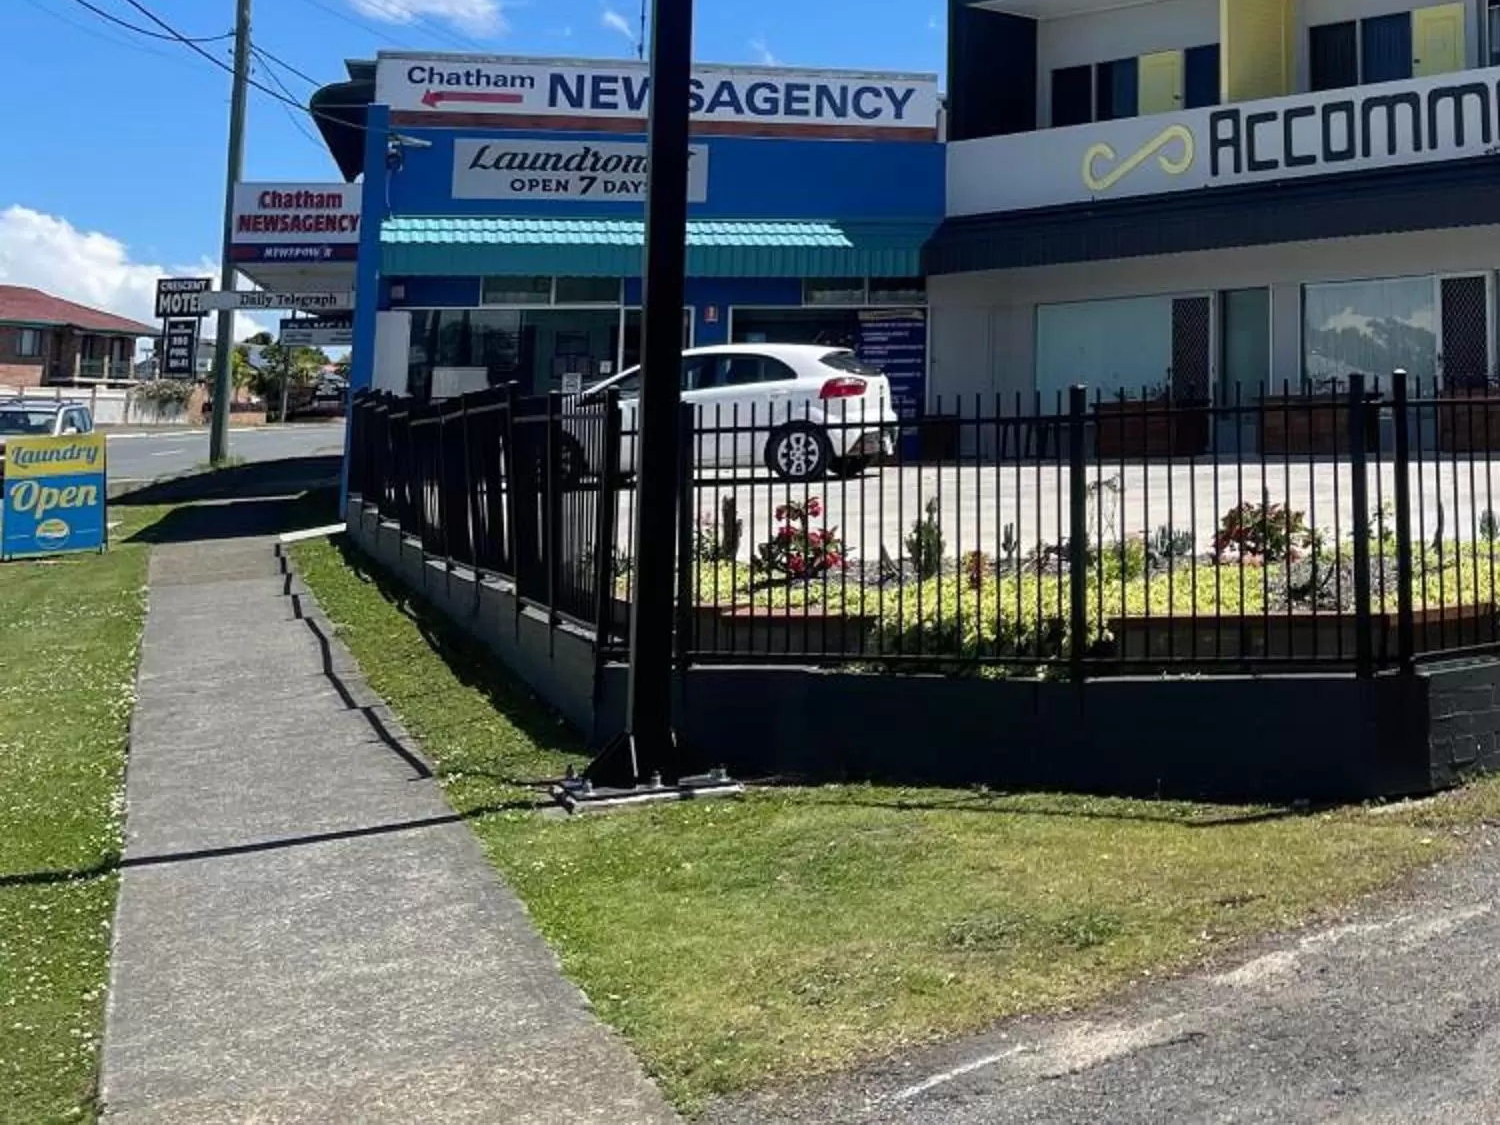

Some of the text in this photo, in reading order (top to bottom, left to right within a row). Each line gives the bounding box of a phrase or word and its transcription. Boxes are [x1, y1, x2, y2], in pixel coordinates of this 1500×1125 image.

[407, 65, 535, 89] Chatham
[468, 144, 697, 174] Laundrom
[510, 178, 570, 193] OPEN
[578, 175, 598, 196] 7
[258, 189, 343, 210] Chatham
[237, 214, 360, 232] NEWSAGENCY
[159, 293, 201, 313] MOTE
[241, 294, 337, 307] Daily Telegraph
[12, 443, 99, 470] Laundry
[10, 479, 98, 520] Open
